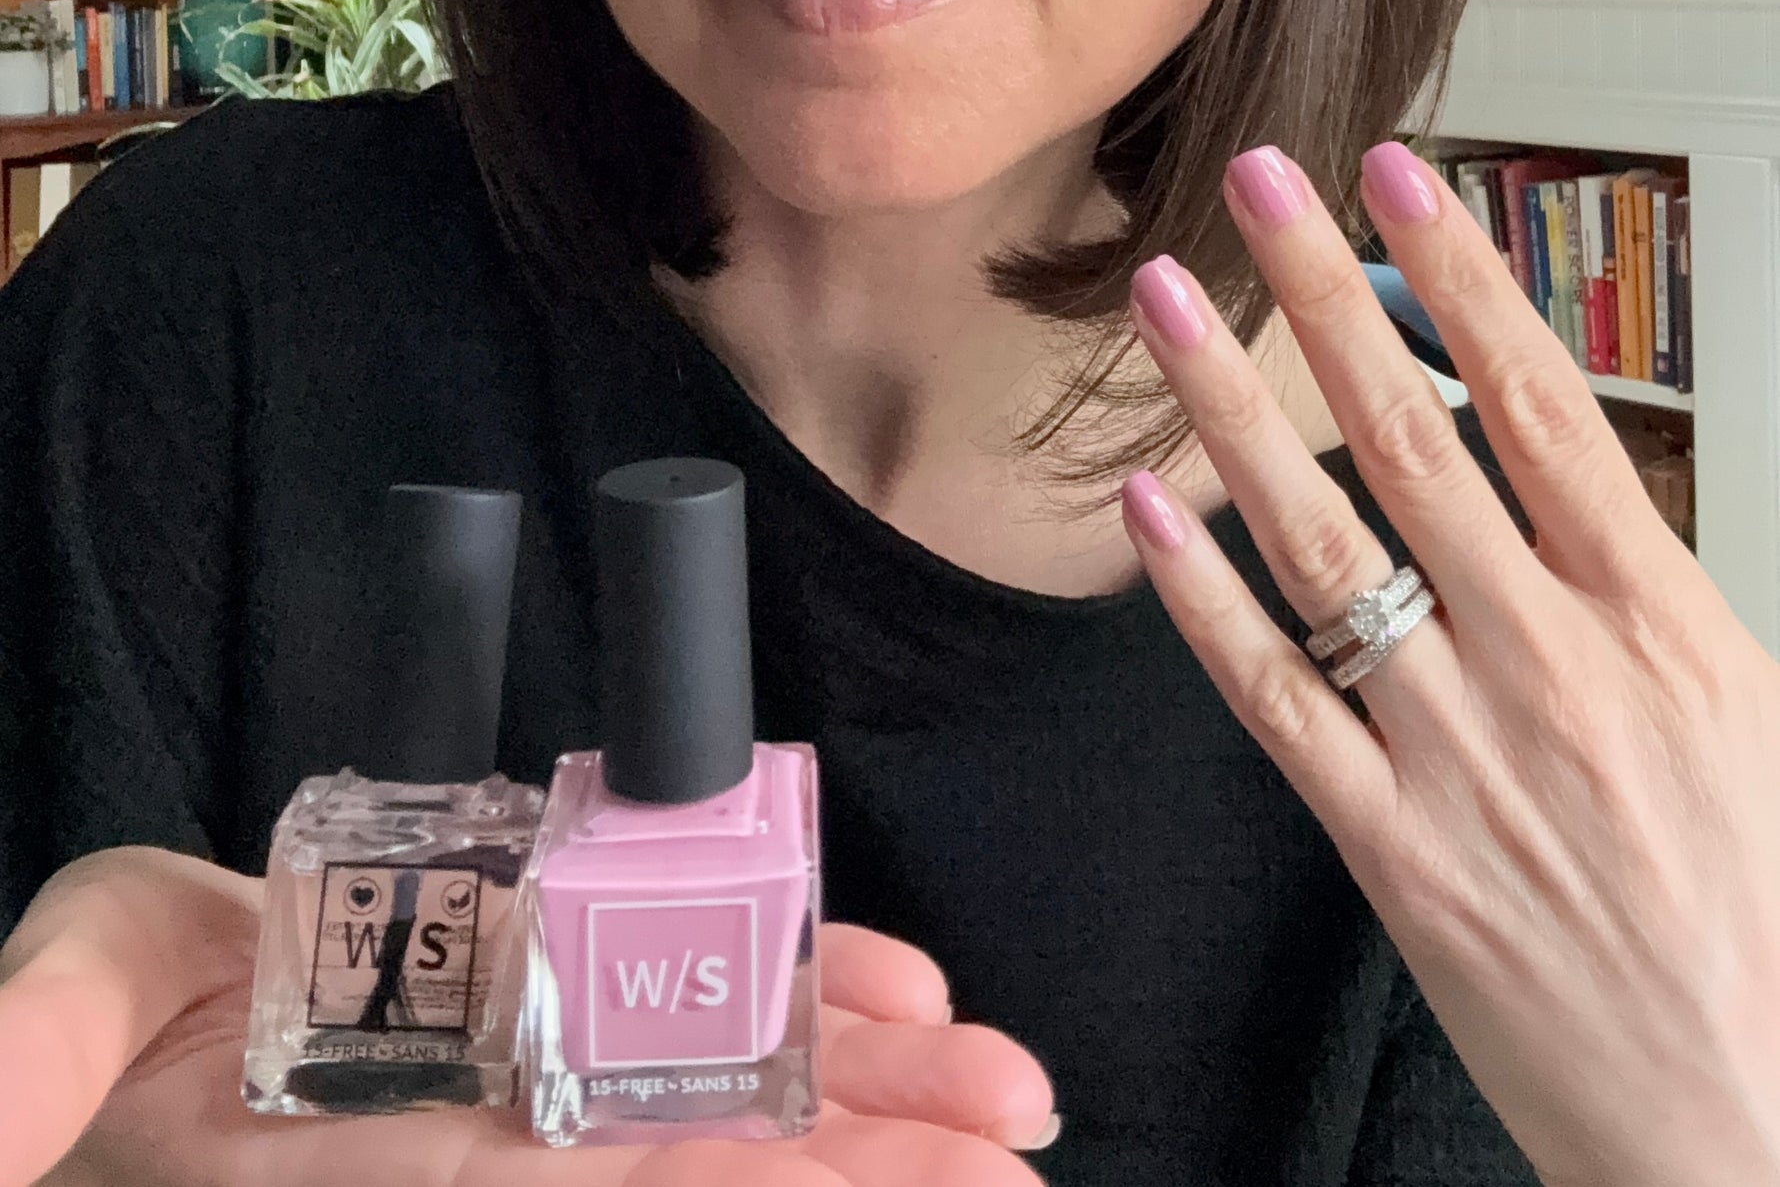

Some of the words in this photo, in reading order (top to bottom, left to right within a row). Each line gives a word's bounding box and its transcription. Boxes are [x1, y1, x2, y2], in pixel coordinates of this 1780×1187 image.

[344, 921, 452, 971] WS
[616, 948, 730, 1014] W/S
[392, 1045, 439, 1062] SANS
[589, 1077, 666, 1096] 15-FREE
[680, 1075, 732, 1095] SANS
[736, 1073, 759, 1092] 15
